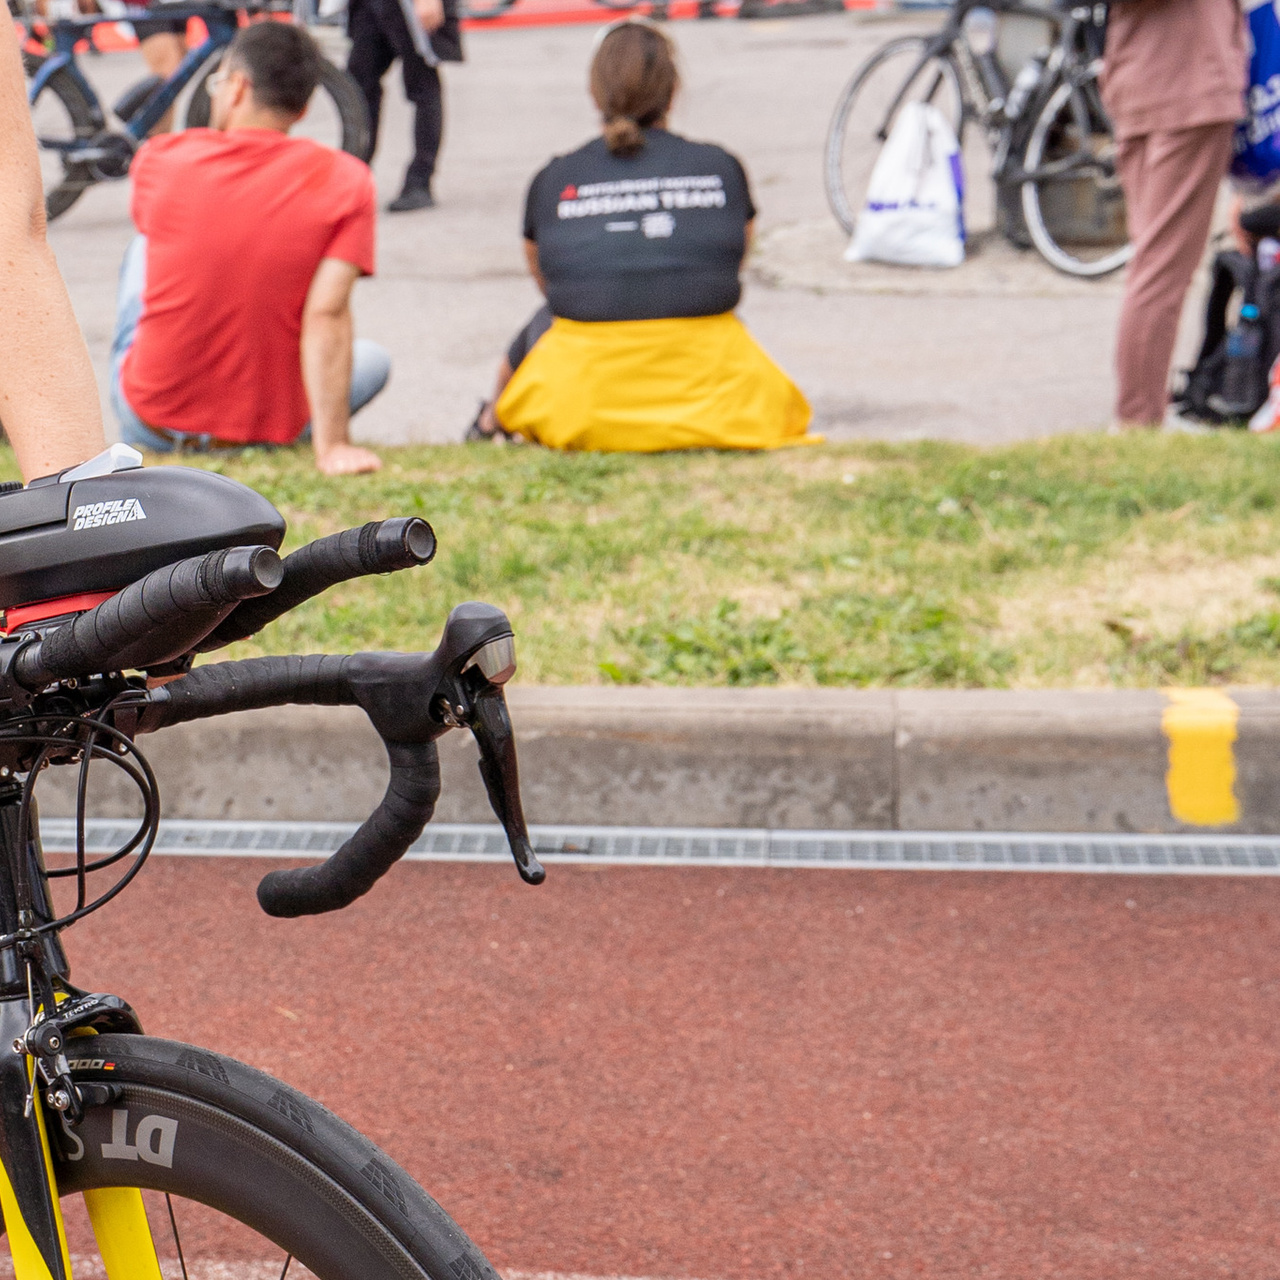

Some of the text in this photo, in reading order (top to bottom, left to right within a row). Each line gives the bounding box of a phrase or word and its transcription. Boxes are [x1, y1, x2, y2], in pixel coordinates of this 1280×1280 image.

[72, 498, 137, 520] PROFILE
[73, 510, 130, 531] DESIGN
[63, 999, 99, 1019] TEKTRO
[100, 1109, 179, 1169] DT
